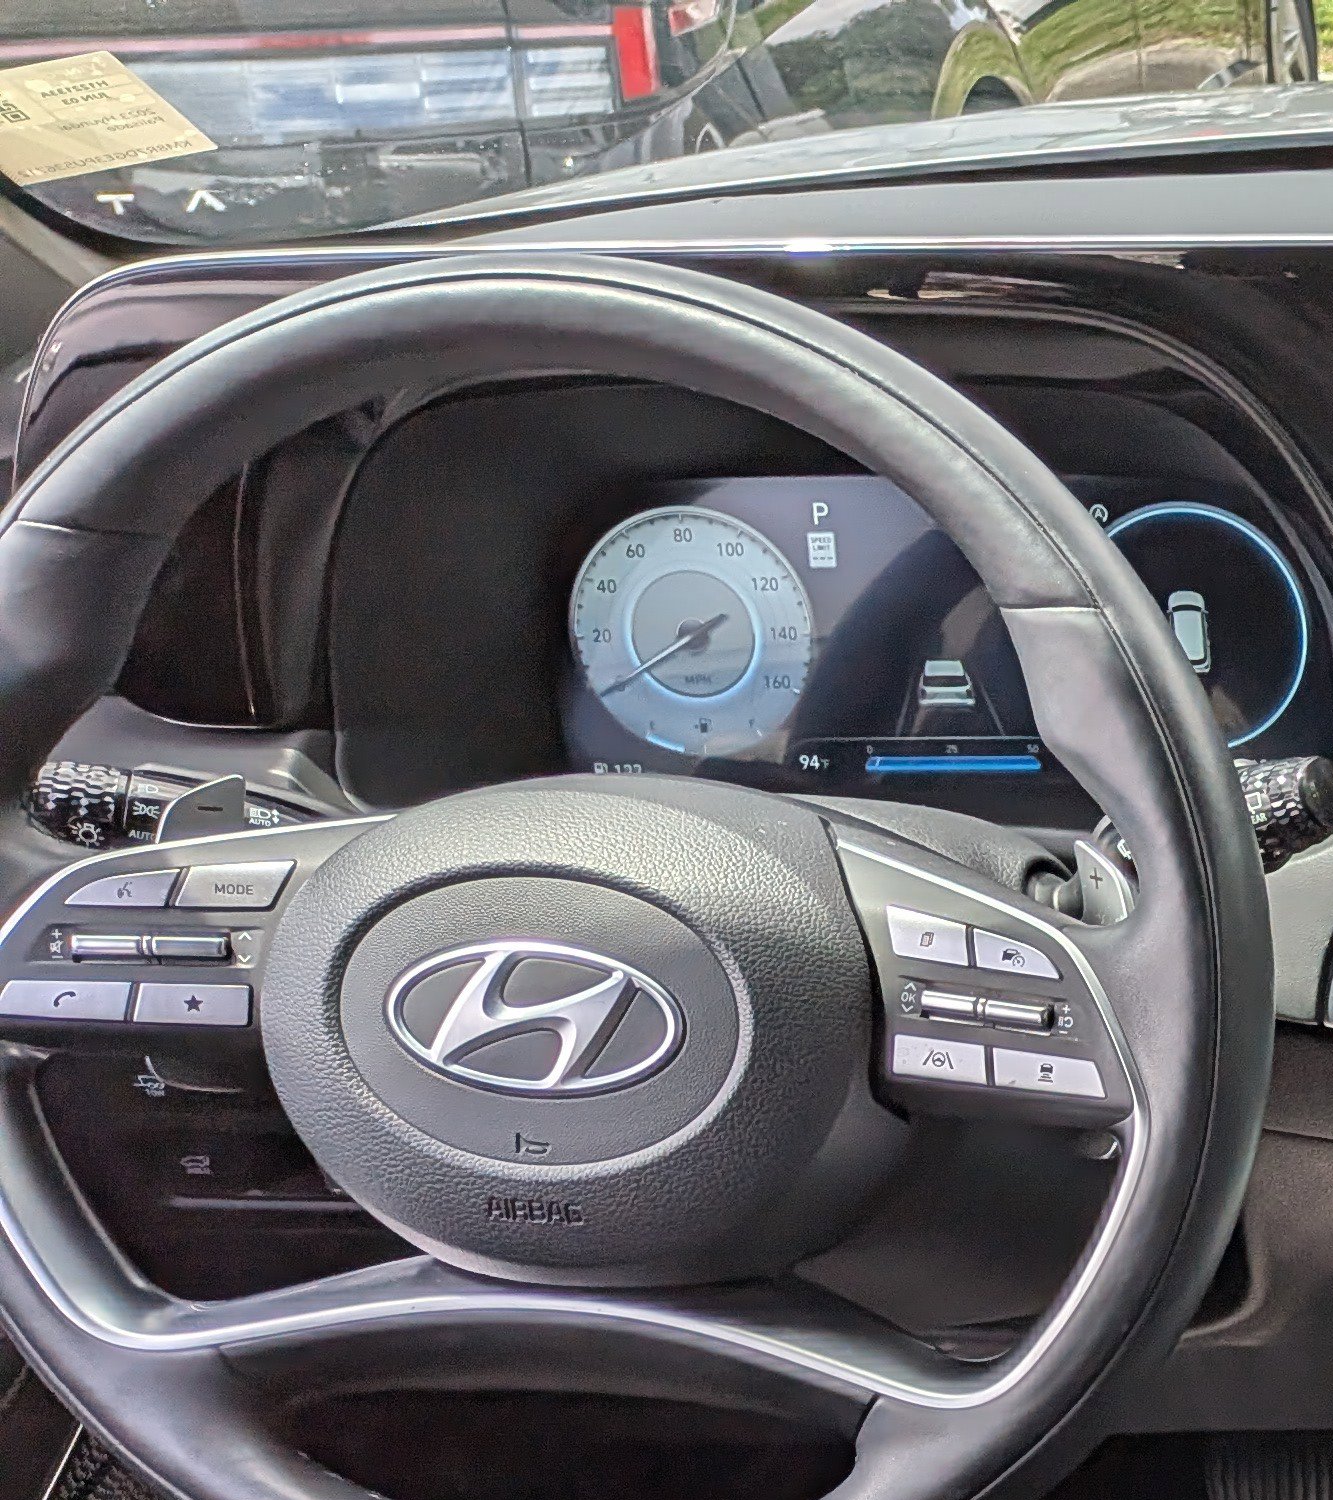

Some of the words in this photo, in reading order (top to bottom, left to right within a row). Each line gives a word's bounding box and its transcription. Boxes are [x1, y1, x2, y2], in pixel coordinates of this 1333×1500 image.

[812, 502, 829, 525] P
[673, 528, 693, 544] 80
[810, 536, 832, 544] SPEED
[625, 543, 645, 558] 60
[716, 542, 744, 557] 100
[596, 578, 617, 594] 40
[751, 577, 779, 592] 120
[592, 629, 612, 643] 20
[770, 626, 798, 641] 140
[764, 675, 791, 690] 160
[248, 817, 271, 827] AUTO
[214, 882, 254, 896] MODE
[900, 992, 916, 1004] OK
[484, 1196, 584, 1227] AIRBAG
